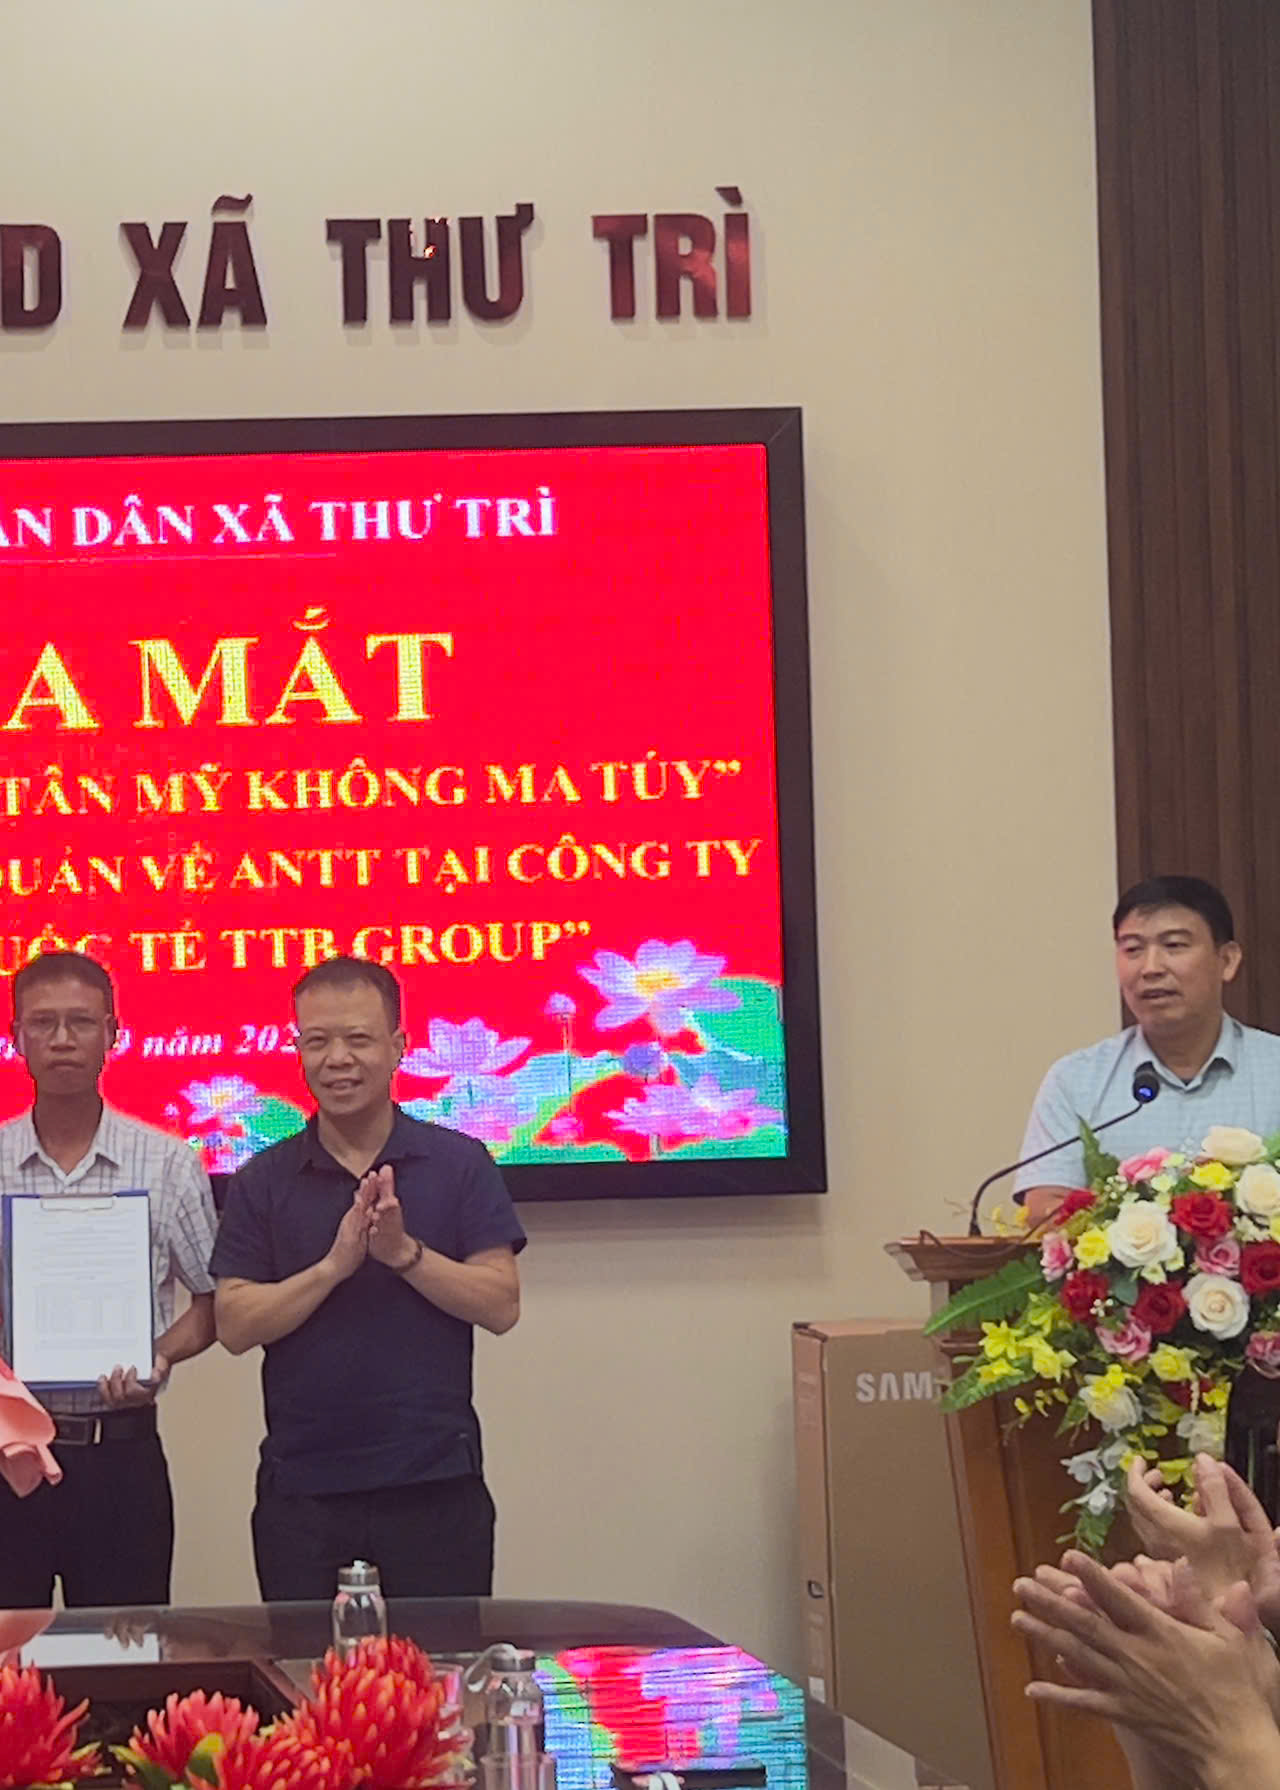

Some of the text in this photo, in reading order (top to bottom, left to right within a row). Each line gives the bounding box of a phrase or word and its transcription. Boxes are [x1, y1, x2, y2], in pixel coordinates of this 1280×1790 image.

[120, 193, 268, 328] XÃ
[326, 203, 534, 326] THƯ
[591, 186, 752, 321] TRÌ
[71, 494, 194, 545] DÂN
[212, 493, 295, 544] XÃ
[310, 493, 442, 541] THƯ
[454, 486, 556, 537] TRÌ
[128, 606, 453, 727] MẮT
[135, 763, 231, 813] MỸ
[246, 757, 466, 811] KHÔNG
[485, 764, 581, 804] MA
[231, 849, 381, 890] ANTT
[396, 846, 492, 893] TẠI
[507, 834, 671, 881] CÔNG
[686, 839, 761, 877] TY
[220, 928, 338, 968] TTB
[142, 1027, 224, 1057] năm
[234, 1021, 301, 1054] 202
